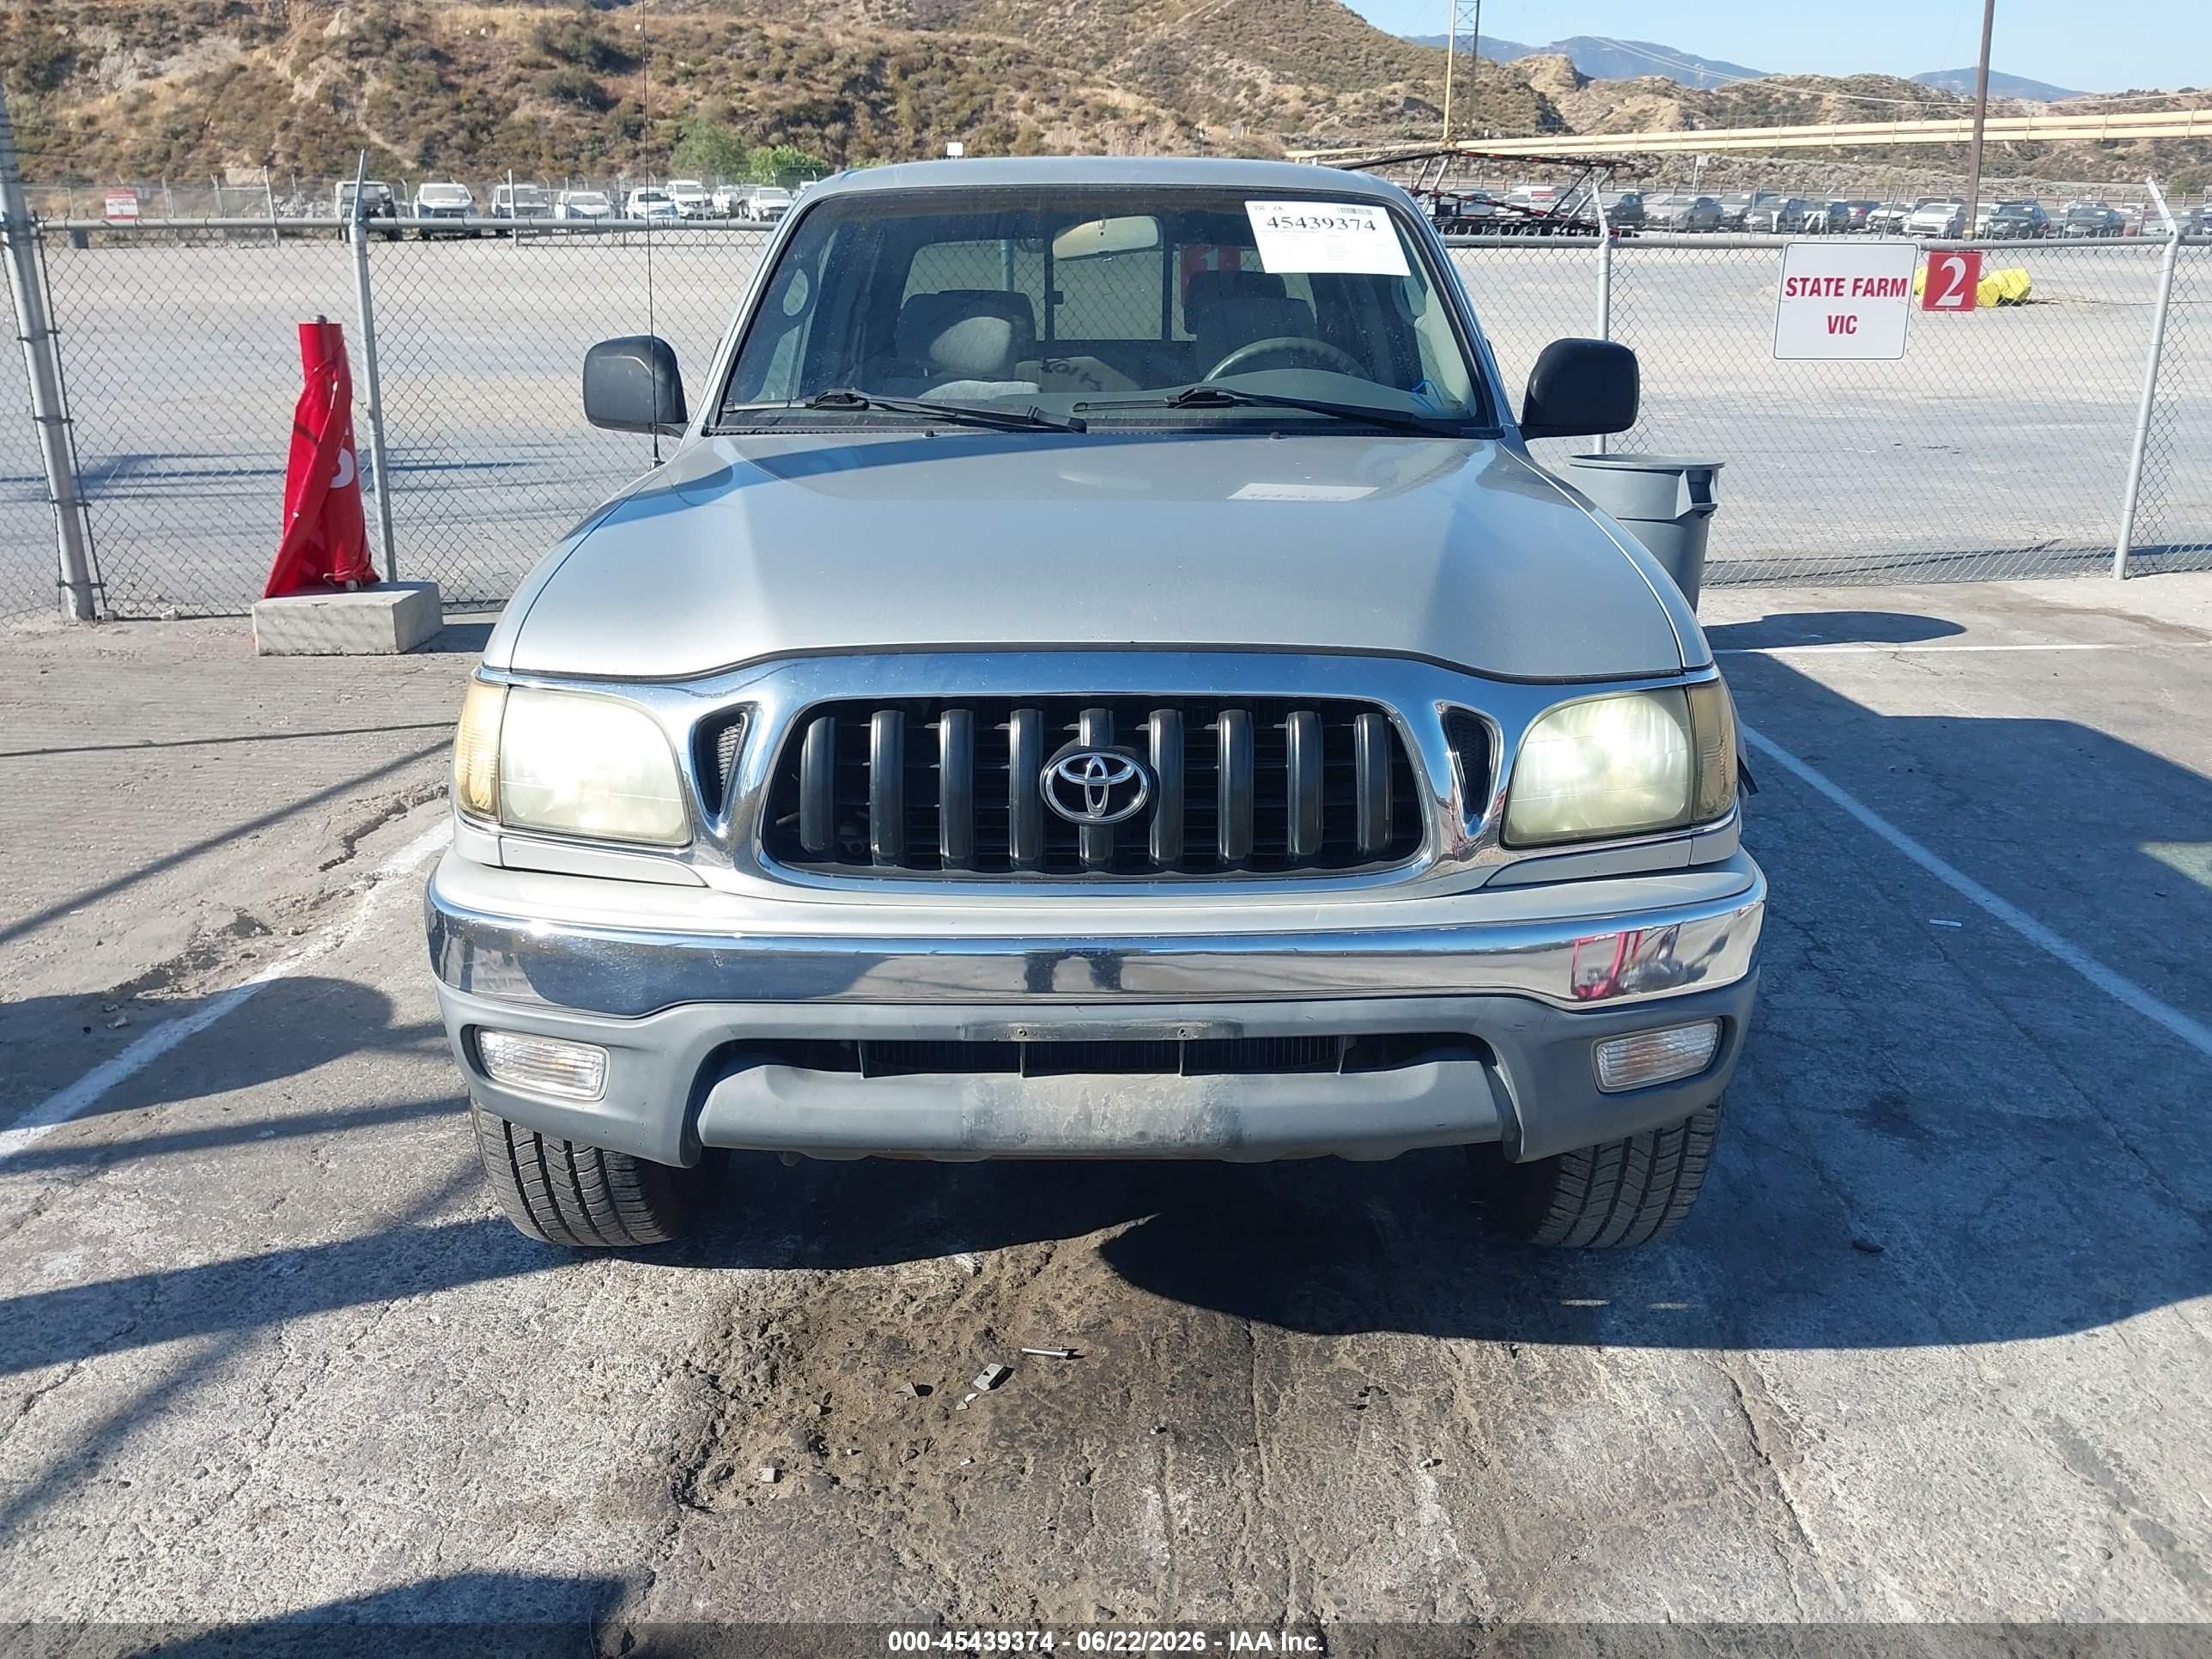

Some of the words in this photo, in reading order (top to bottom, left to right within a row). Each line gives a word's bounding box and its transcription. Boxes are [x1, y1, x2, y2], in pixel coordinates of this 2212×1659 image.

[1267, 216, 1377, 232] 45439374
[1785, 276, 1845, 297] STATE
[1851, 277, 1908, 298] FARM
[1935, 256, 1966, 307] 2
[1826, 314, 1858, 335] VIC
